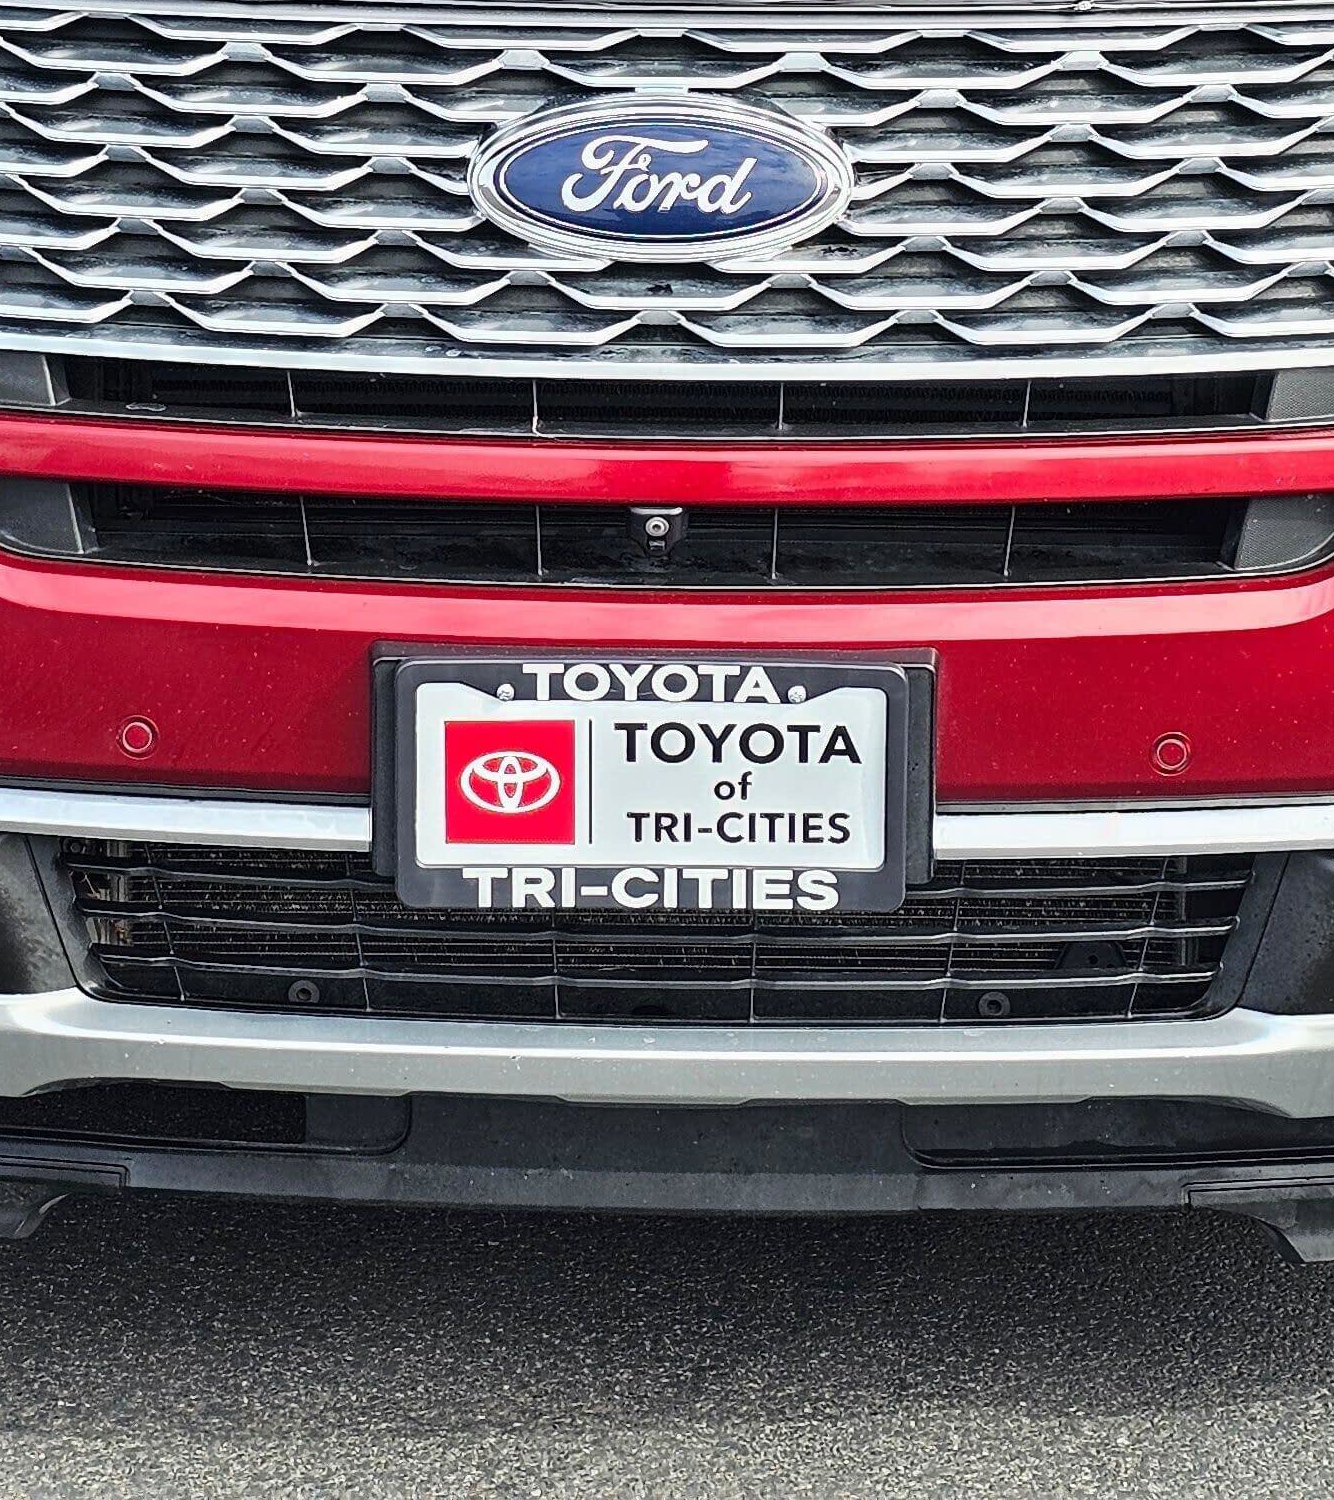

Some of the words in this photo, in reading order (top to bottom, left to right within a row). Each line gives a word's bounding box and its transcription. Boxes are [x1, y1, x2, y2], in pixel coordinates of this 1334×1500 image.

[561, 135, 758, 214] Ford
[522, 664, 780, 704] TOYOTA
[615, 722, 861, 764] TOYOTA
[714, 772, 752, 801] of
[627, 812, 850, 844] TRI-CITIES
[462, 868, 839, 911] TRI-CITIES
